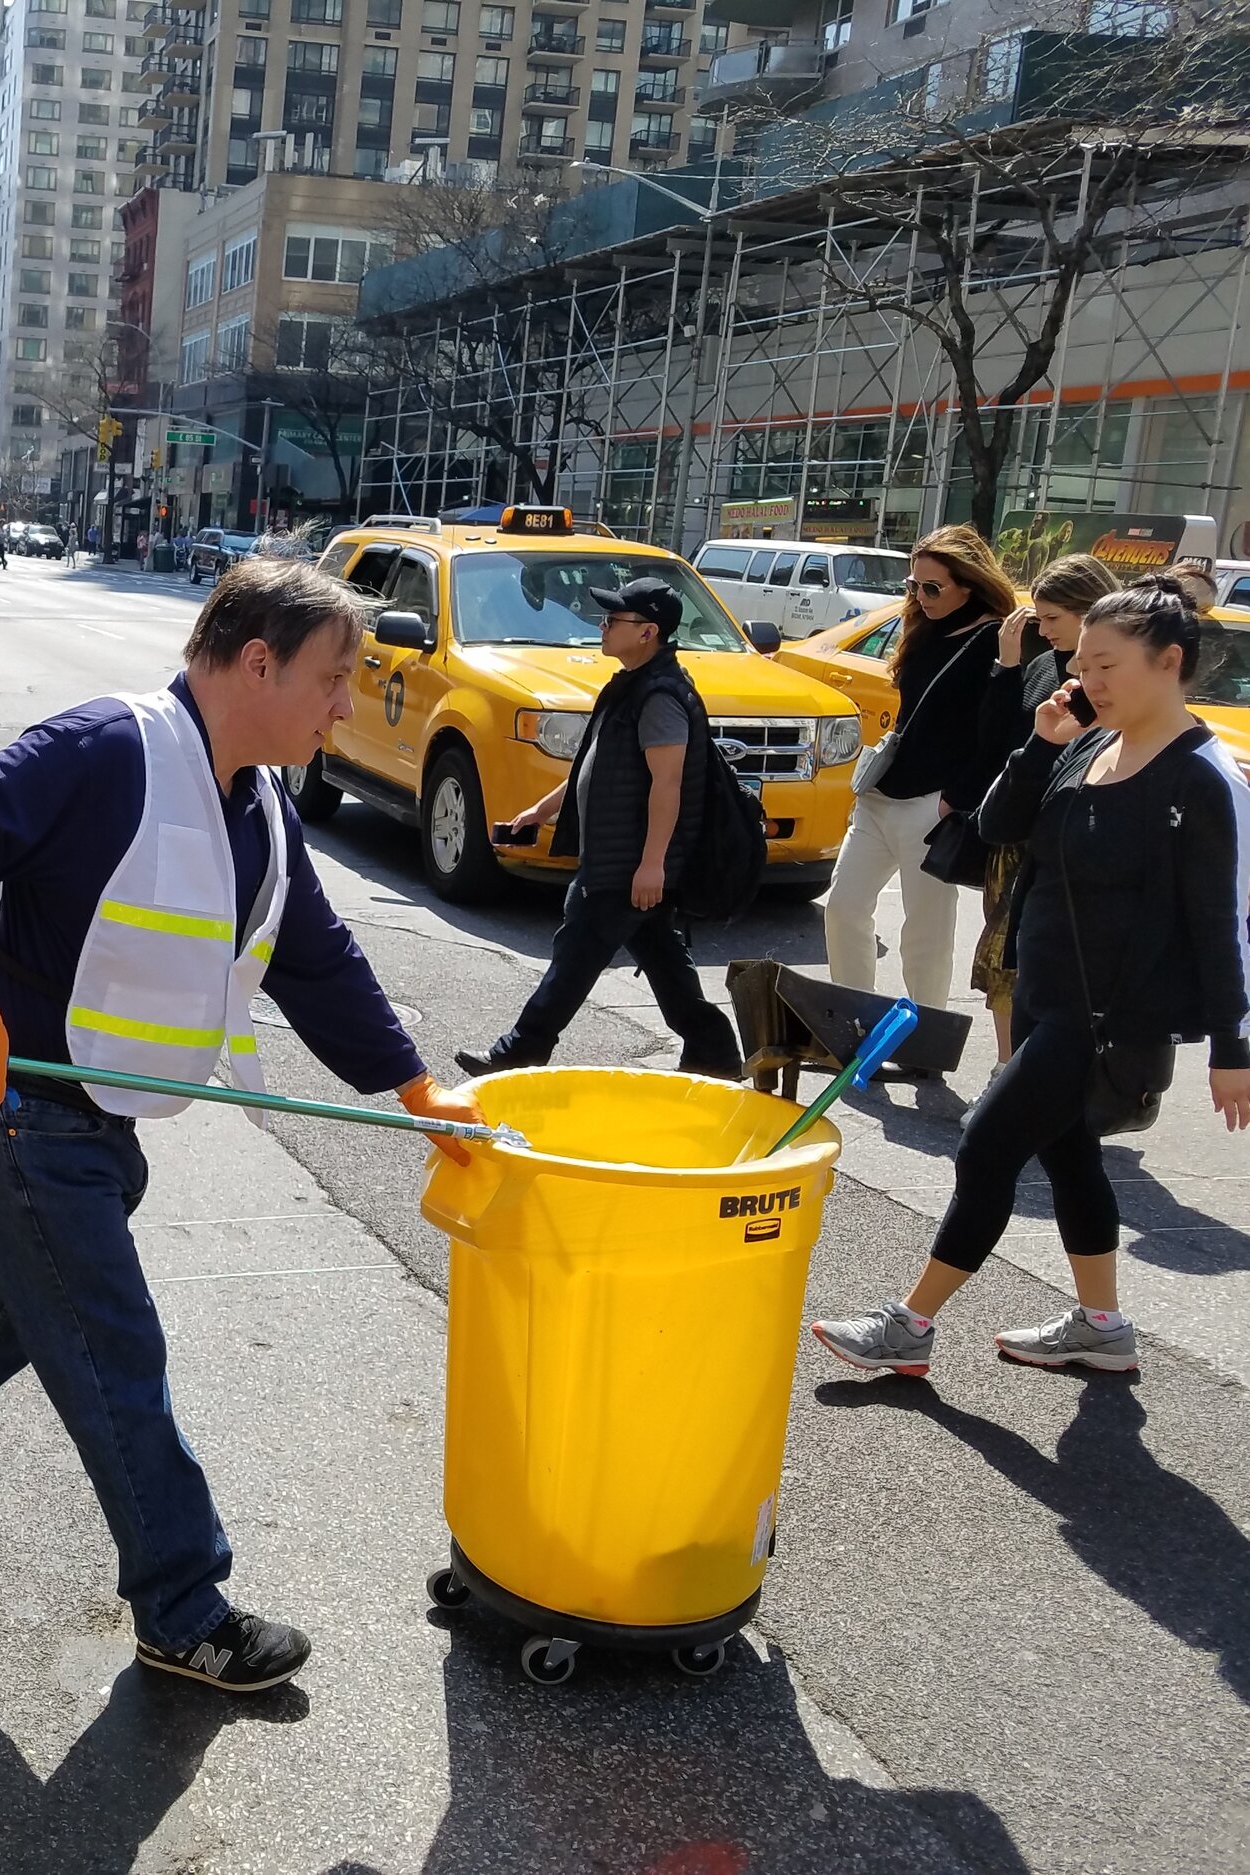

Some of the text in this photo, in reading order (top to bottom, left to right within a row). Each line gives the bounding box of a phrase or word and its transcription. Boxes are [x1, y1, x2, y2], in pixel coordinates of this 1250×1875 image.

[336, 434, 362, 442] ENTER
[769, 505, 789, 516] FOOD
[525, 513, 553, 528] 8E81
[719, 1185, 802, 1218] BRUTE
[188, 1642, 234, 1679] N
